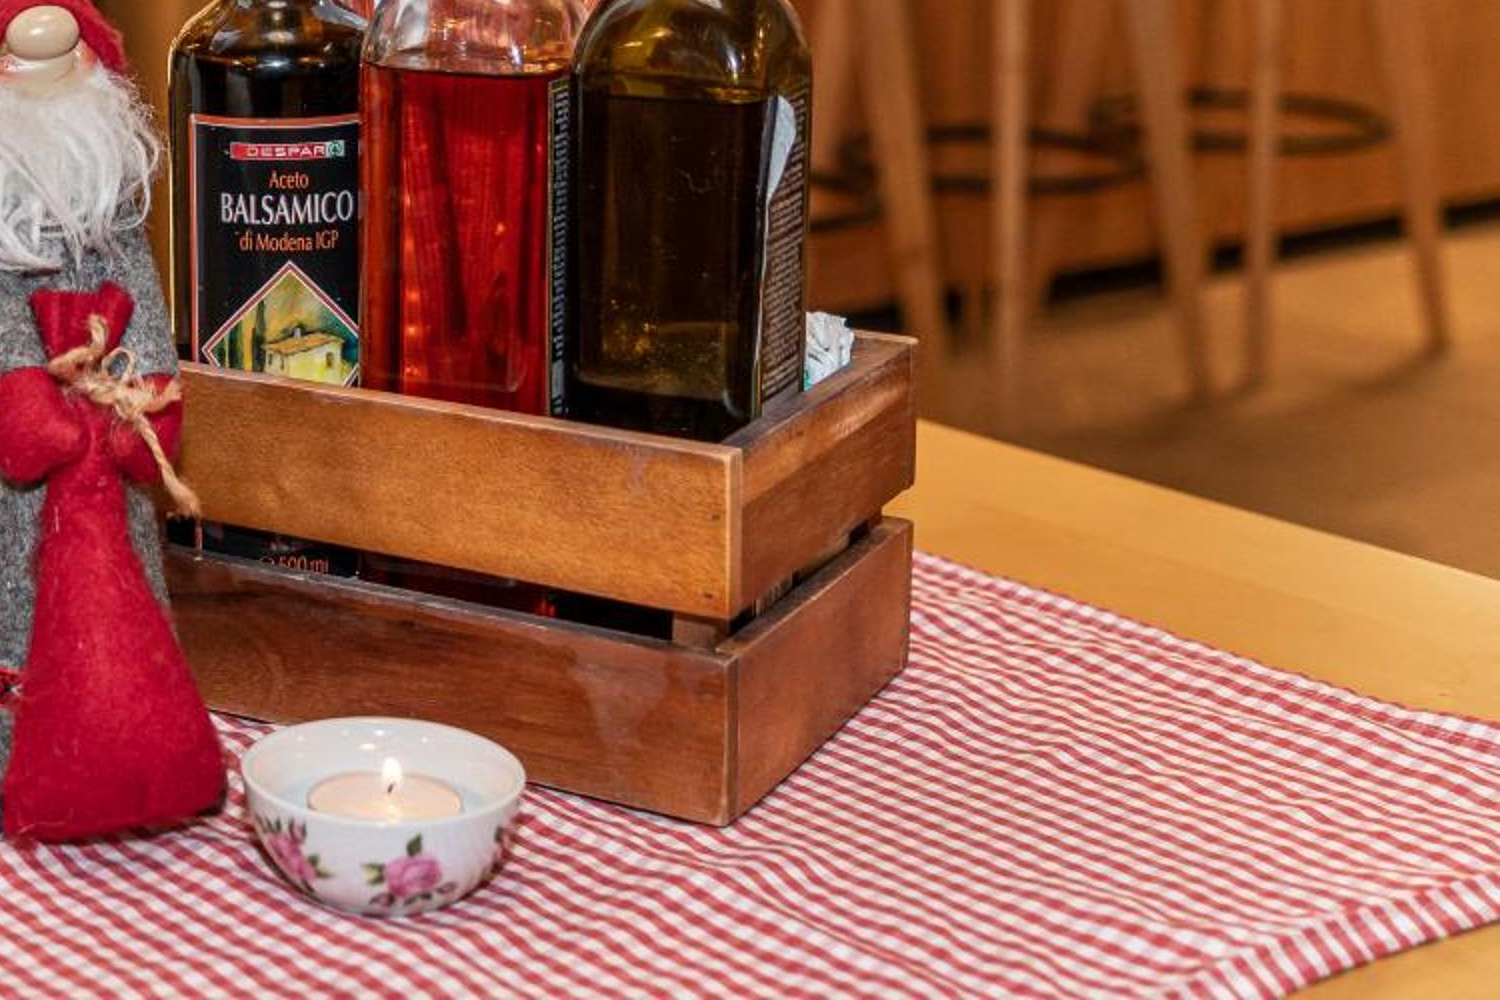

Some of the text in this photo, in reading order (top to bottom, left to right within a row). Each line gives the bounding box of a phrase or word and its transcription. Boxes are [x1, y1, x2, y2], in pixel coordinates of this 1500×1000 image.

[246, 145, 326, 157] DESPAR
[269, 170, 309, 189] Aceto
[220, 189, 354, 226] BALSAMICO
[239, 230, 339, 251] di Modena IGP
